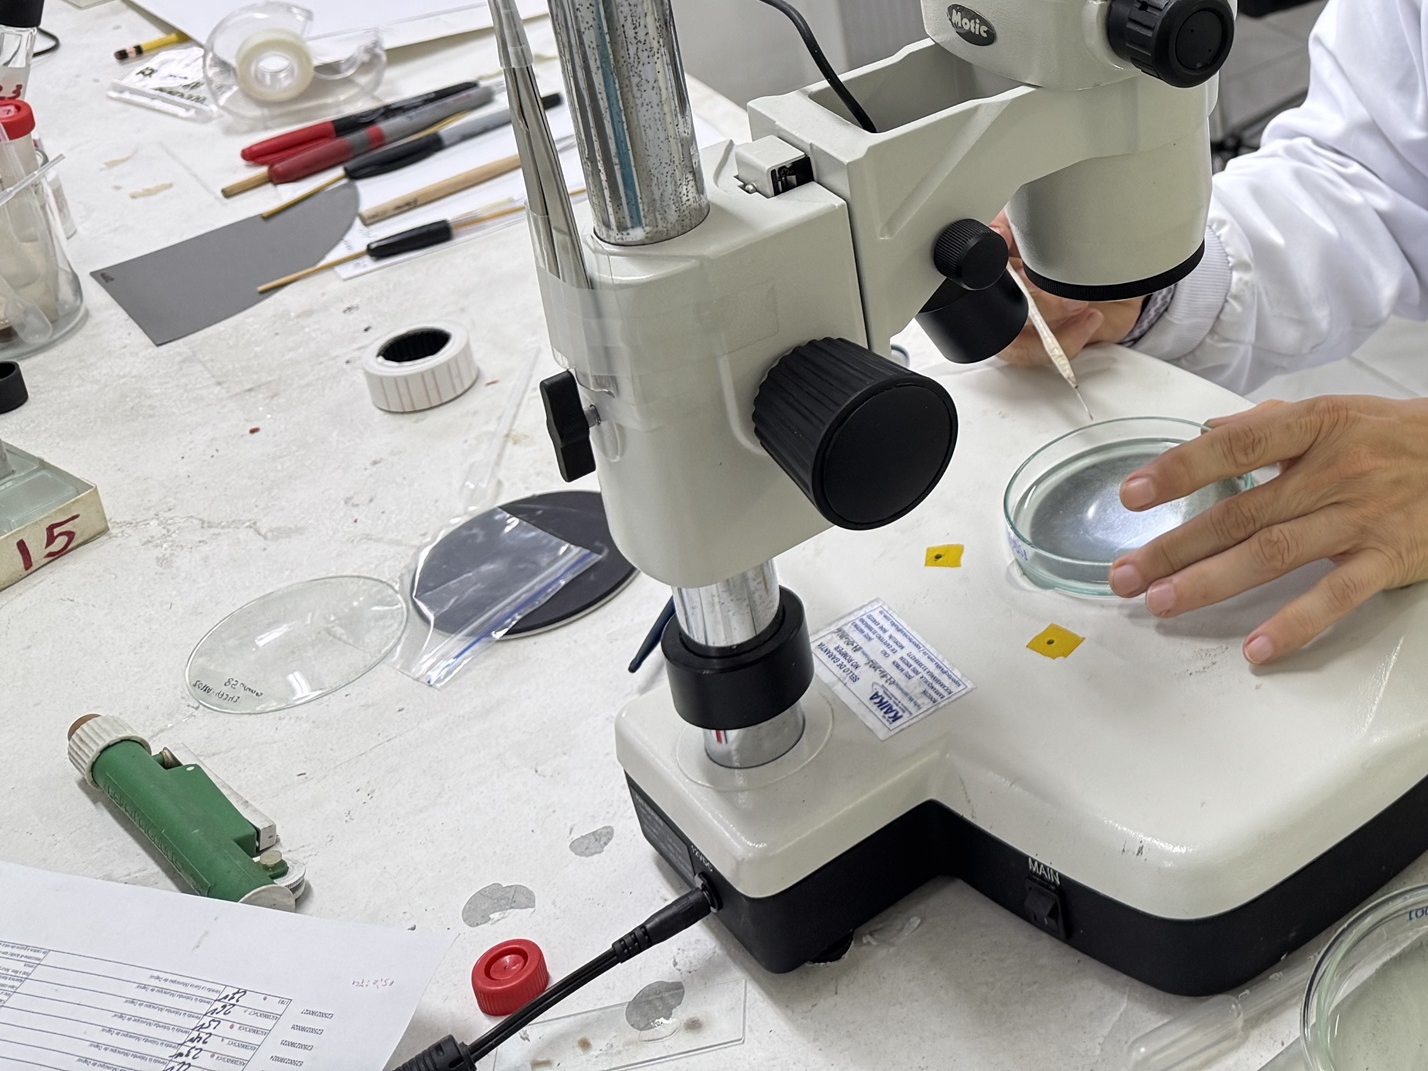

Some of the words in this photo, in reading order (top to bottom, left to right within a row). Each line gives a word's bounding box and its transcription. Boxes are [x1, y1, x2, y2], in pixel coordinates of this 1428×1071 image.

[951, 8, 989, 38] Motic
[16, 513, 81, 571] 15
[841, 667, 860, 682] SELLO
[866, 690, 904, 722] KAIKA
[1028, 857, 1061, 886] MAIN
